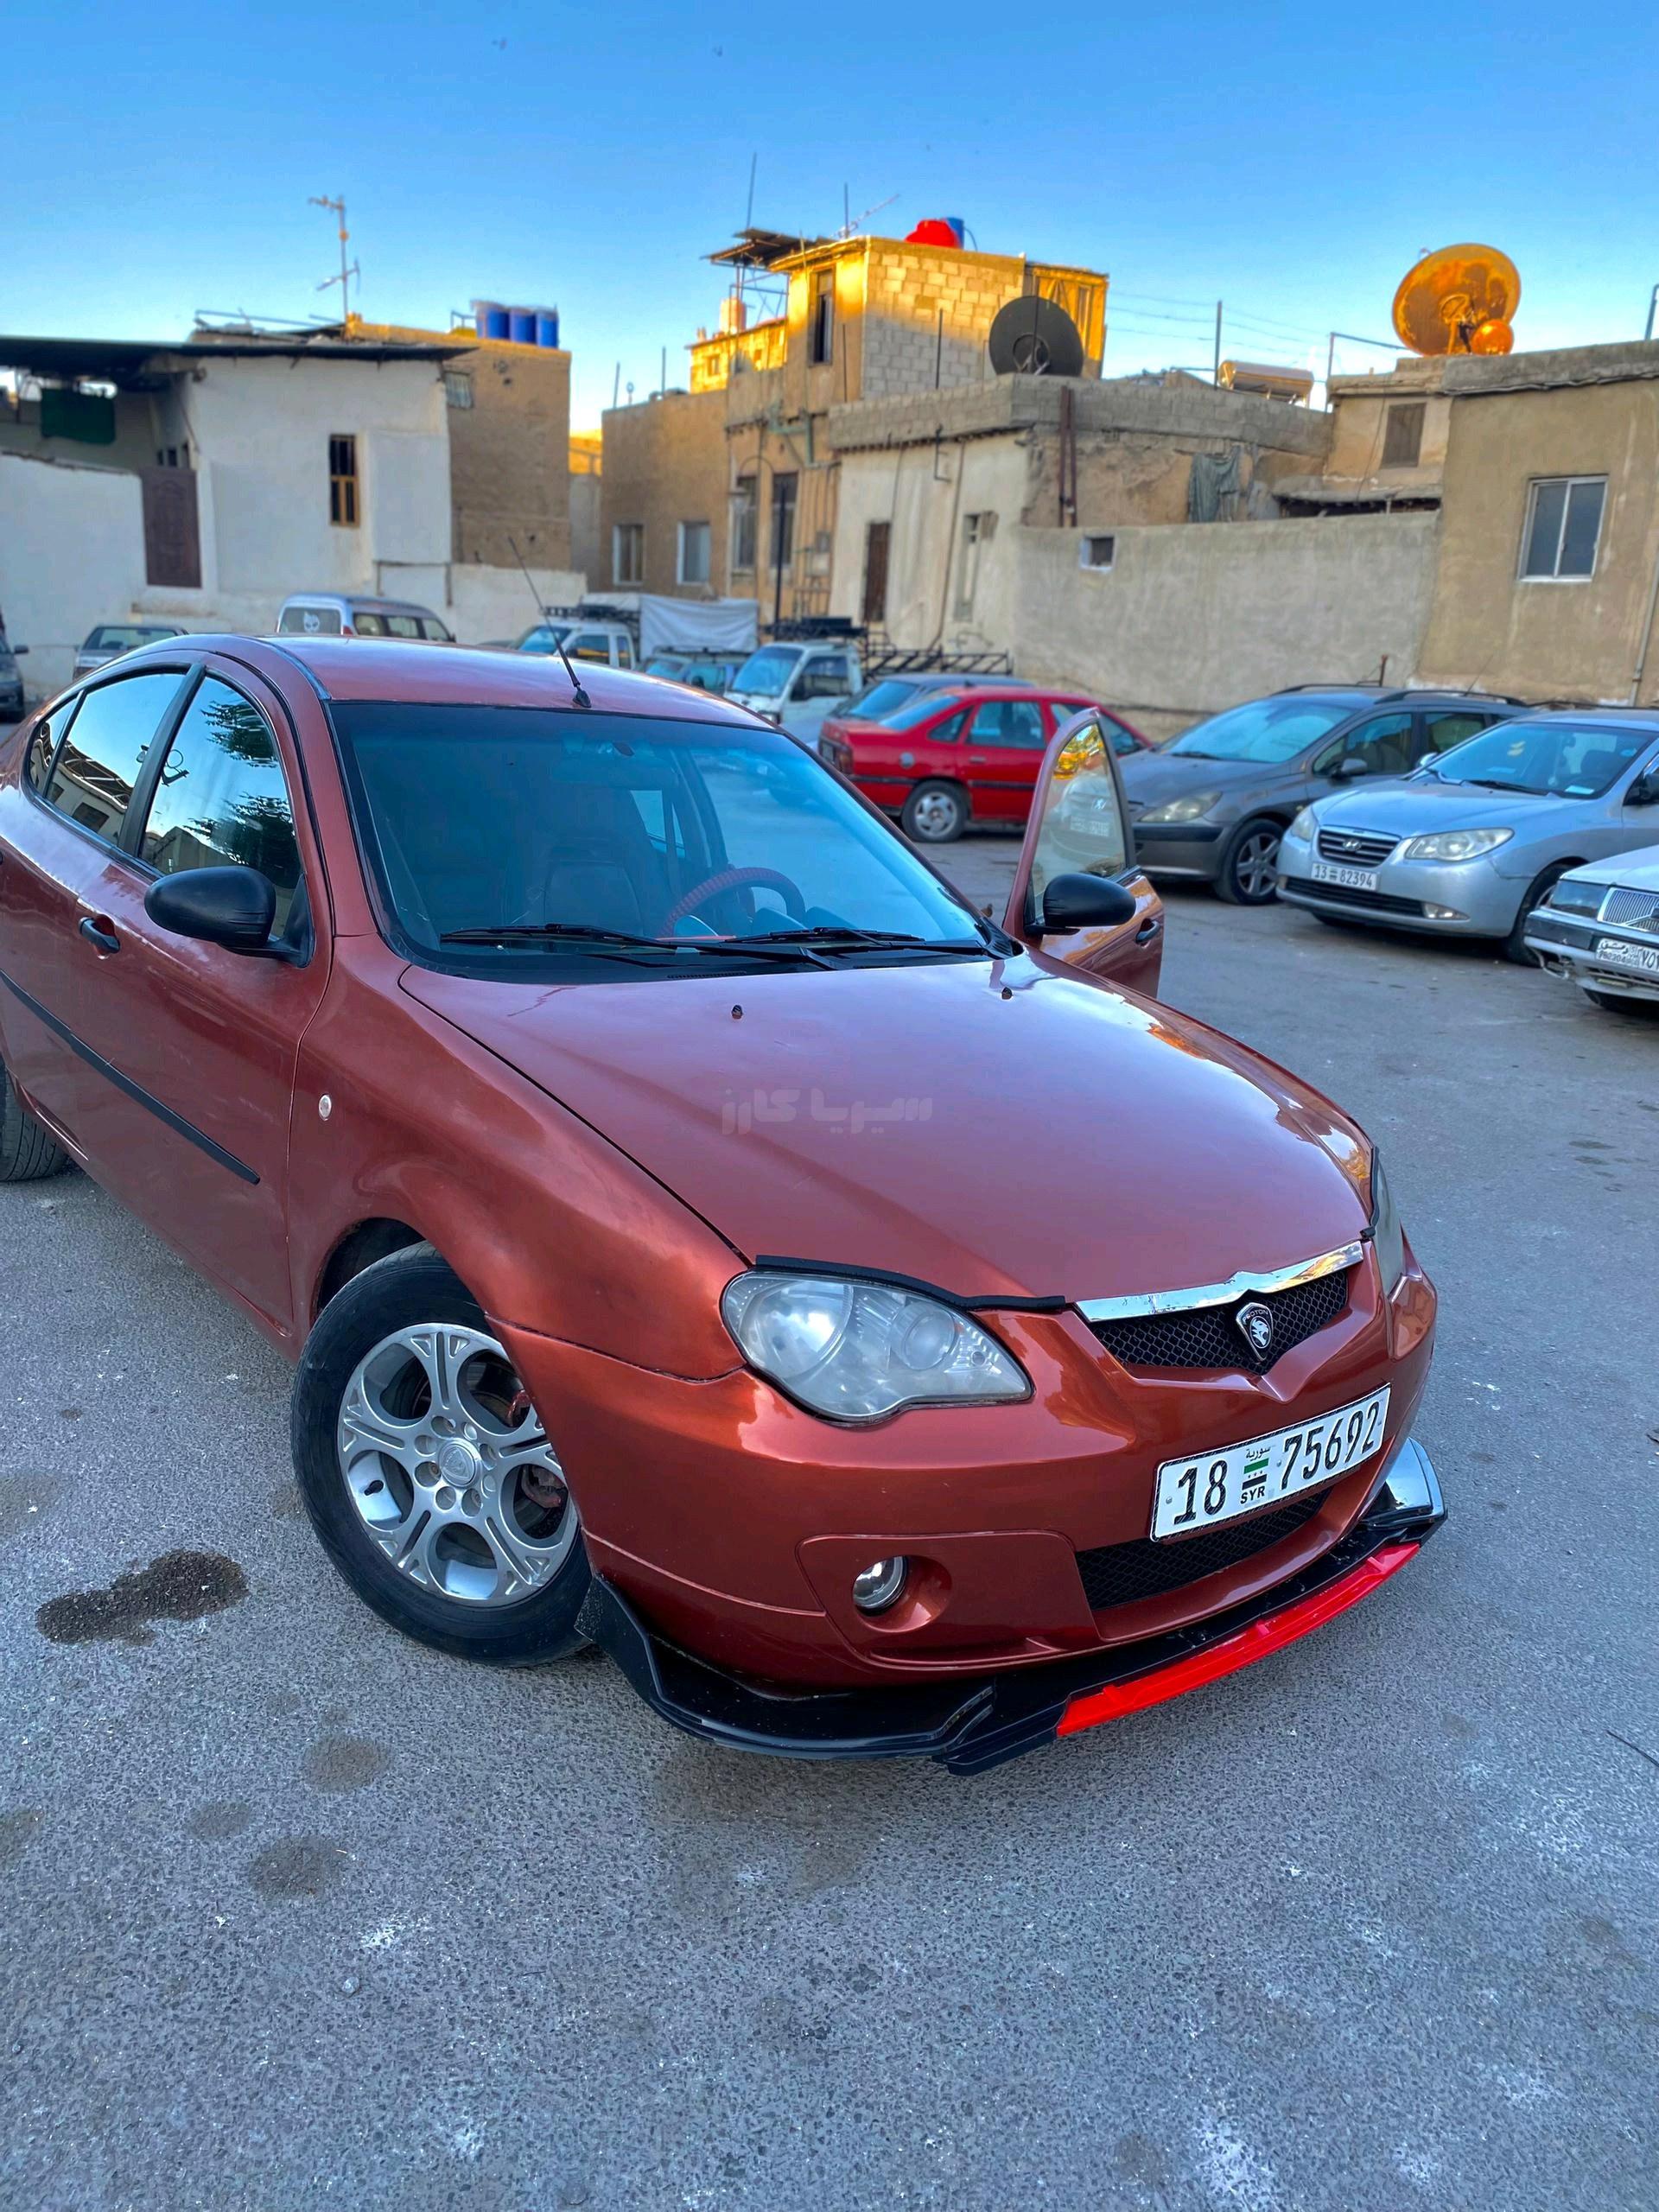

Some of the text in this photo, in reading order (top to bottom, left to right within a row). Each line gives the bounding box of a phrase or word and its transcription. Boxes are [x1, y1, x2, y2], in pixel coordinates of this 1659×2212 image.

[1314, 865, 1373, 887] 13 82394
[1242, 1309, 1268, 1325] PROTON
[1173, 1401, 1380, 1525] 18 75692
[1245, 1446, 1271, 1462] سورية
[1240, 1485, 1266, 1504] SYR
